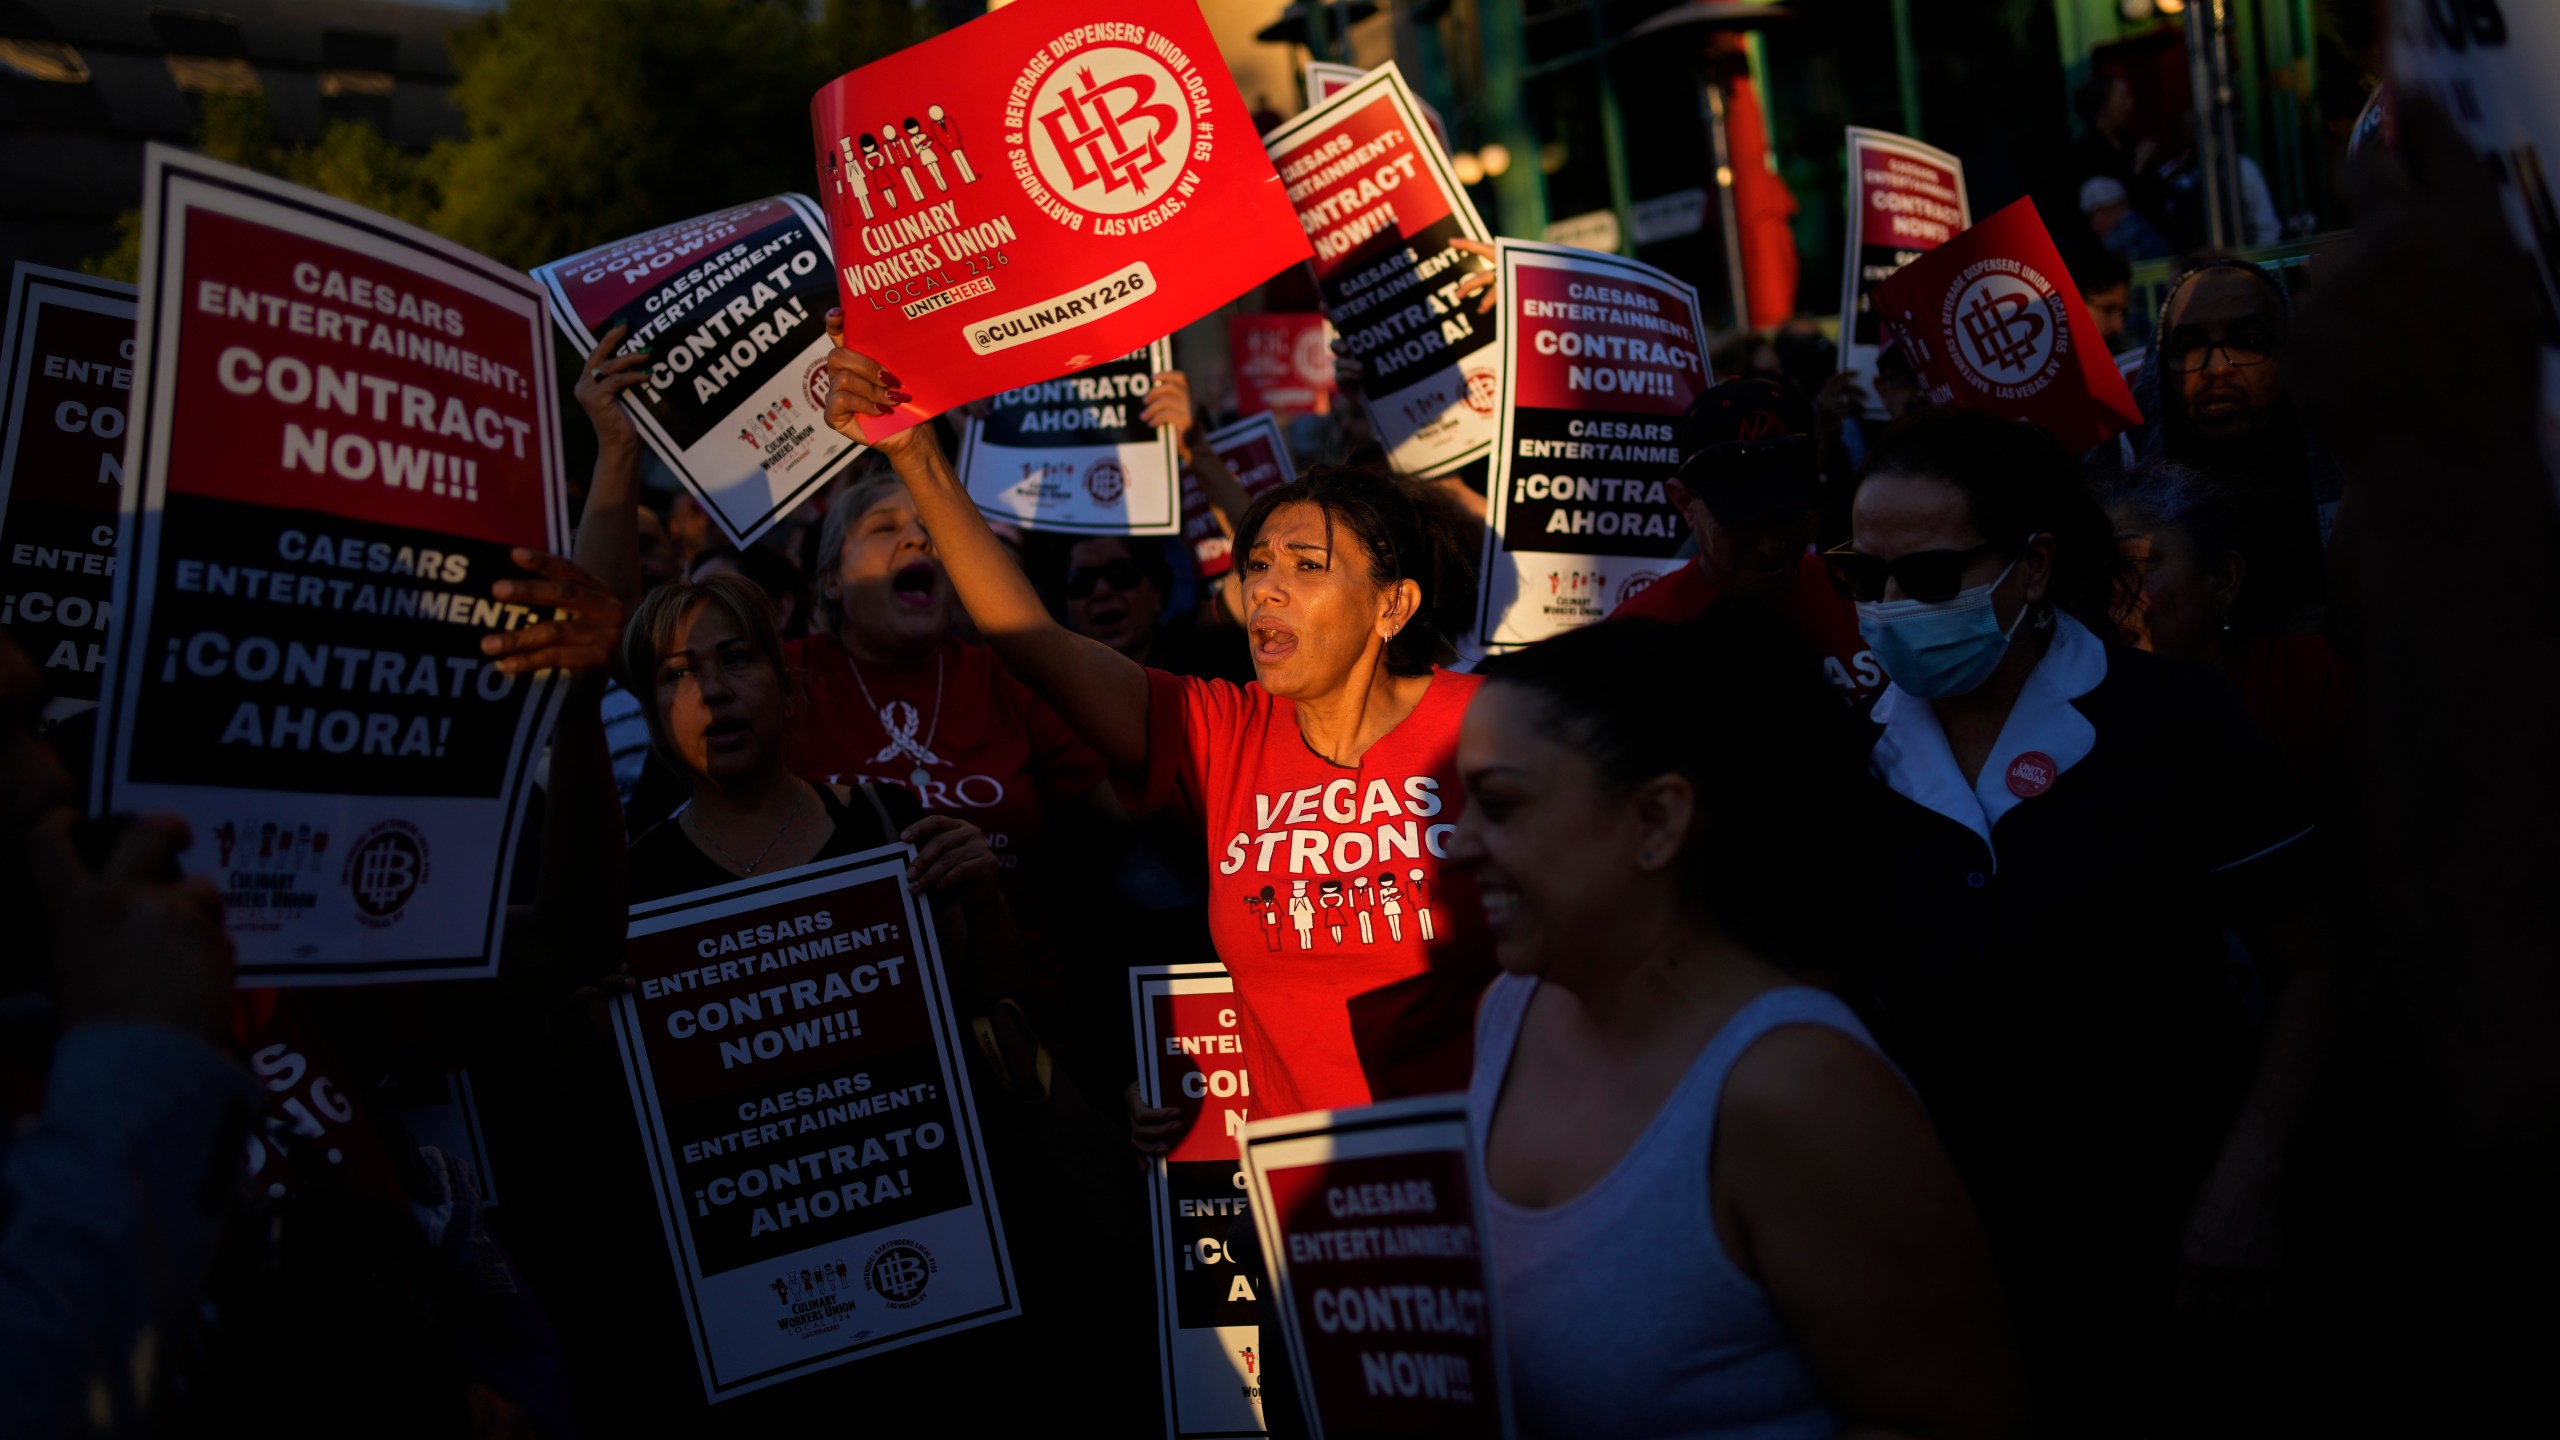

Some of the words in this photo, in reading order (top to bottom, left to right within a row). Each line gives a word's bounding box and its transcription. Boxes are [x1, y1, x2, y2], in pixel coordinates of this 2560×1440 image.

[1048, 22, 1146, 60] DISPENSERS
[1145, 31, 1191, 73] UNION
[1004, 49, 1054, 128] BEVERAGE
[1181, 66, 1213, 119] LOCAL
[1004, 132, 1025, 145] &
[1193, 121, 1214, 162] #165
[1008, 148, 1084, 231] BARTENDERS
[1093, 217, 1127, 236] LAS
[1125, 196, 1187, 235] VEGAS,
[1177, 168, 1201, 198] NV
[1299, 151, 1416, 235] ONTRACT
[622, 223, 738, 285] NOW!!!
[843, 243, 943, 297] WORKERS
[936, 214, 1017, 262] UNION
[861, 199, 961, 257] CULINARY
[291, 260, 466, 338] CAESARS
[644, 243, 749, 313] CAESARS
[869, 270, 956, 311] LOCAL
[965, 251, 1009, 275] 226
[903, 277, 994, 318] UNITEHERE!
[1338, 246, 1419, 298] CAESARS
[1568, 282, 1661, 314] CAESARS
[1962, 257, 2022, 280] DISPENSERS
[2020, 264, 2052, 294] UNION
[2045, 289, 2067, 324] LOCAL
[199, 279, 530, 399] ENTERTAINMENT:
[640, 249, 818, 405] ¡CONTRATO
[974, 273, 1144, 348] @CULINARY226
[1522, 298, 1696, 344] ENTERTAINMENT:
[692, 295, 810, 405] AHORA!
[1374, 311, 1474, 378] AHORA!
[1534, 329, 1699, 374] CONTRACT
[216, 345, 532, 460] CONTRACT
[1568, 364, 1675, 398] NOW!!!
[1995, 385, 2015, 399] LAS
[1019, 403, 1128, 434] AHORA!
[1567, 418, 1674, 442] CAESARS
[280, 423, 480, 502] NOW!!!
[1518, 438, 1681, 465] ENTERTAINME
[1513, 472, 1668, 505] ¡CONTRA
[1544, 507, 1679, 539] AHORA!
[277, 528, 471, 585] CAESARS
[174, 558, 540, 631] ENTERTAINMENT:
[159, 630, 516, 701] ¡CONTRATO
[218, 701, 455, 758] AHORA!
[2011, 768, 2047, 785] UNIDAD
[2019, 762, 2047, 777] UNITY
[1255, 775, 1444, 831] VEGAS
[641, 922, 901, 1001] ENTERTAINMENT:
[697, 910, 834, 960] CAESARS
[666, 955, 906, 1040] CONTRACT
[718, 1008, 863, 1072] NOW!!!
[682, 1082, 938, 1165] ENTERTAINMENT:
[737, 1071, 872, 1124] CAESARS
[694, 1119, 946, 1218] ¡CONTRATO
[749, 1169, 914, 1241] AHORA!
[1326, 1177, 1438, 1221] CAESARS
[777, 1310, 824, 1331] WORKERS
[825, 1300, 857, 1318] UNION
[791, 1294, 836, 1316] CULINARY
[1312, 1282, 1486, 1341] CONTRACT
[1358, 1350, 1476, 1406] NOW!!!
